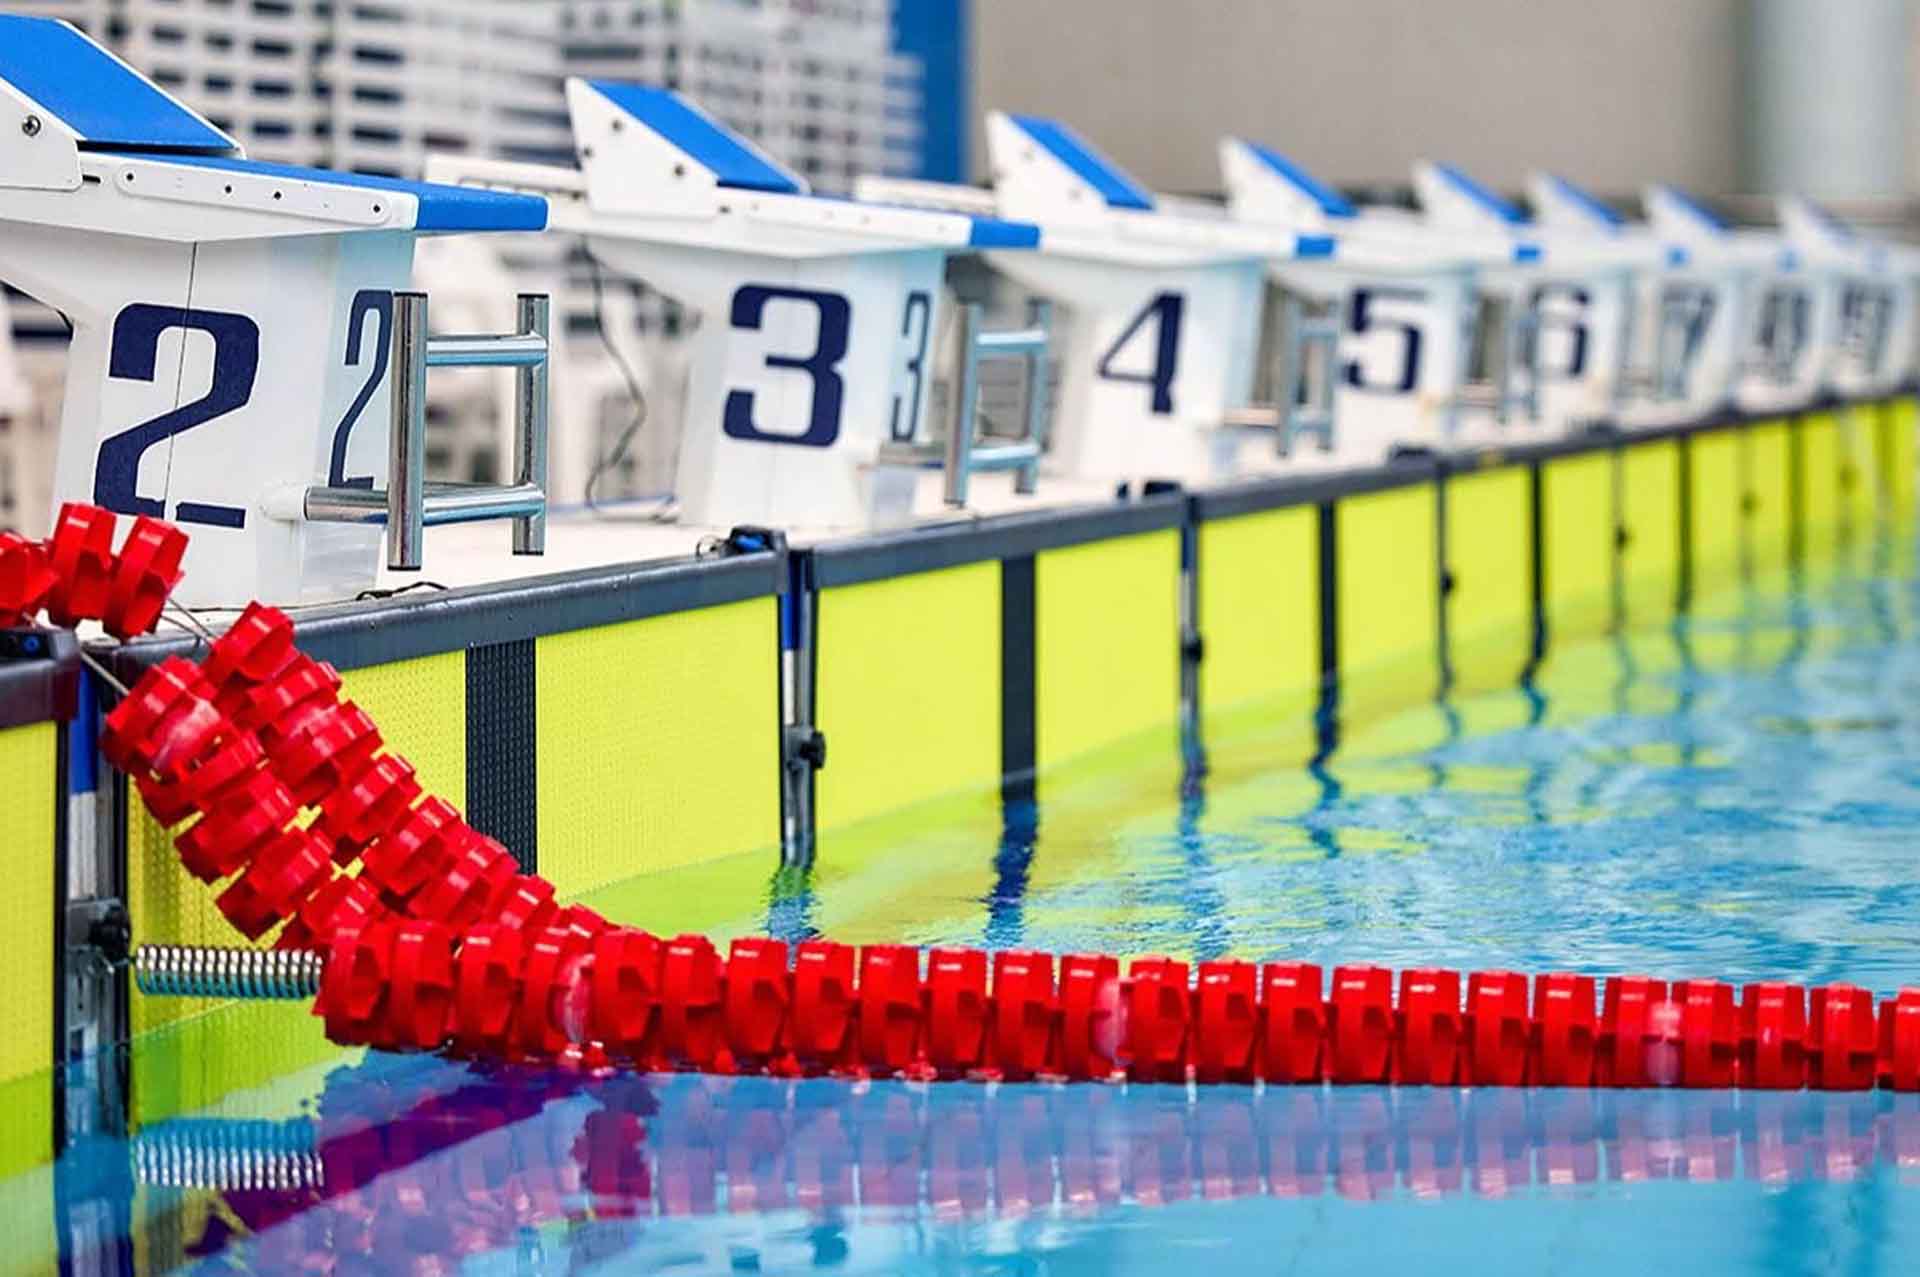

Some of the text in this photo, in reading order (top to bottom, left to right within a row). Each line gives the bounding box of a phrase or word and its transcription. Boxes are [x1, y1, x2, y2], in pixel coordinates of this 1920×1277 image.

[94, 302, 260, 528] 2
[328, 289, 394, 488] 2
[722, 284, 851, 447] 3
[890, 291, 931, 442] 3
[1096, 291, 1187, 416] 4
[1341, 286, 1428, 393] 5
